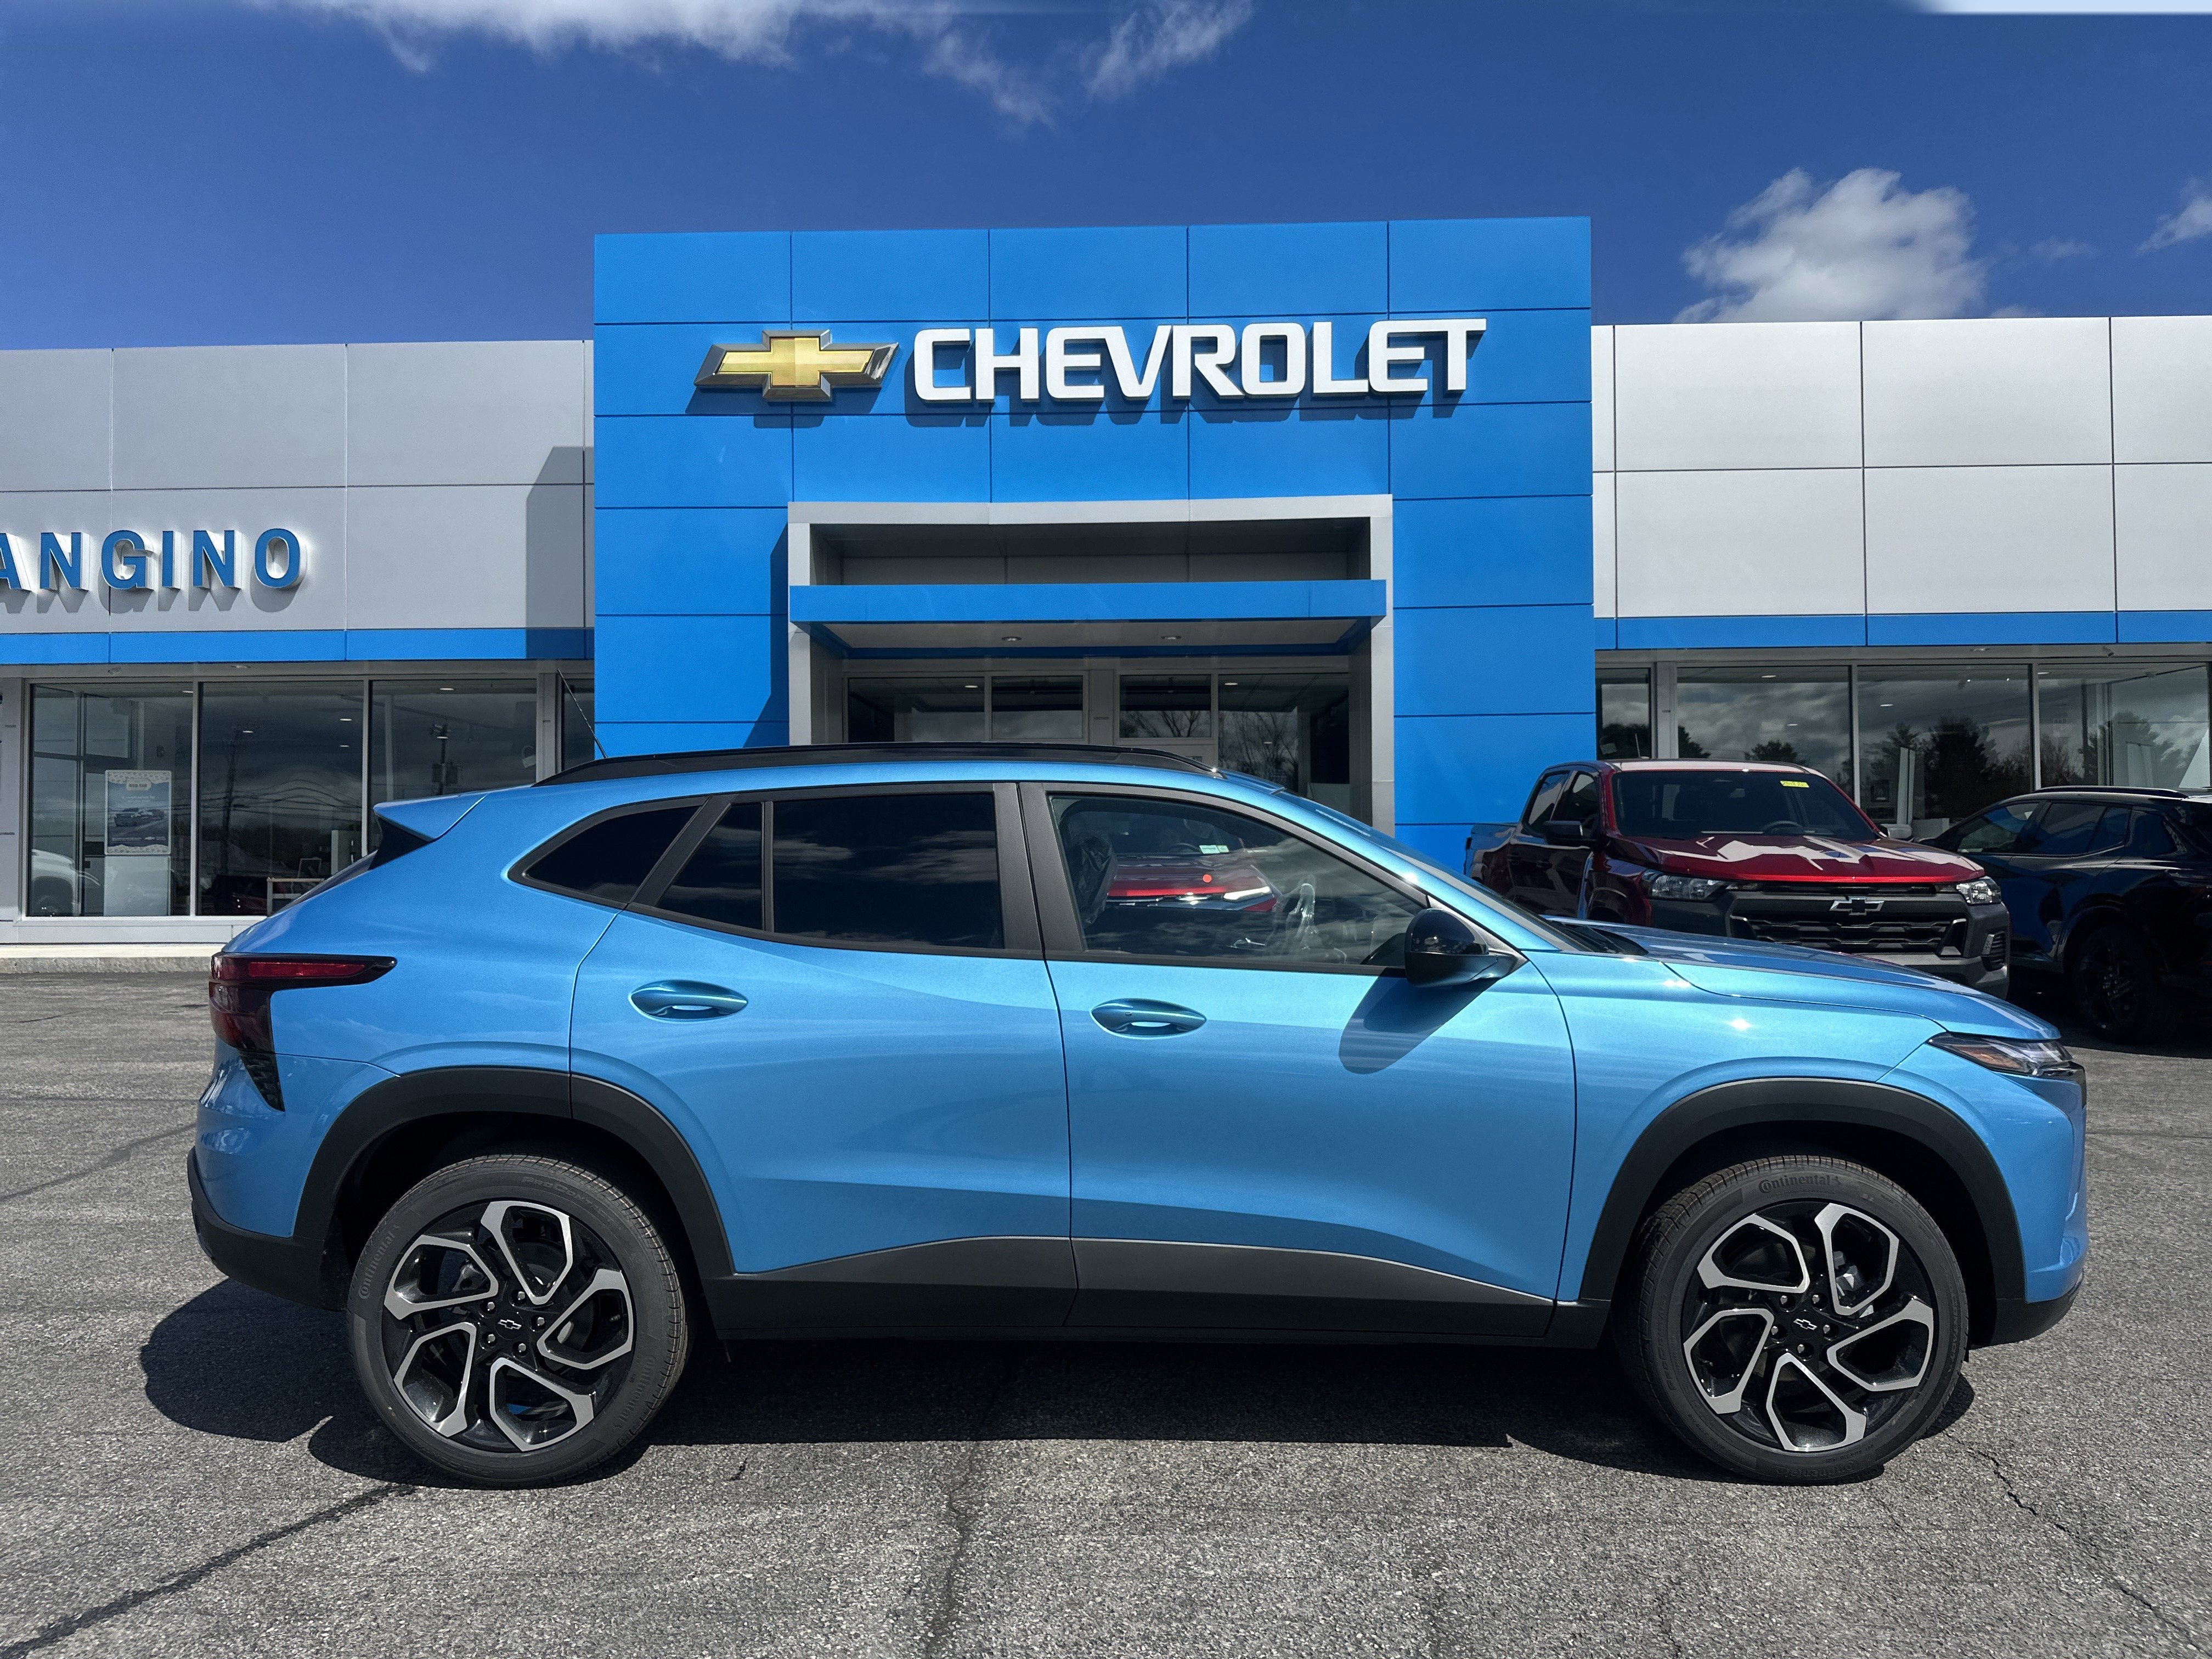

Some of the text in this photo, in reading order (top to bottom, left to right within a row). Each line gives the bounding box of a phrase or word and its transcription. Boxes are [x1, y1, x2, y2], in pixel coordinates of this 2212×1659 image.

[913, 318, 1487, 403] CHEVROLET
[1758, 1175, 1831, 1194] Continental
[358, 1230, 396, 1300] Continental
